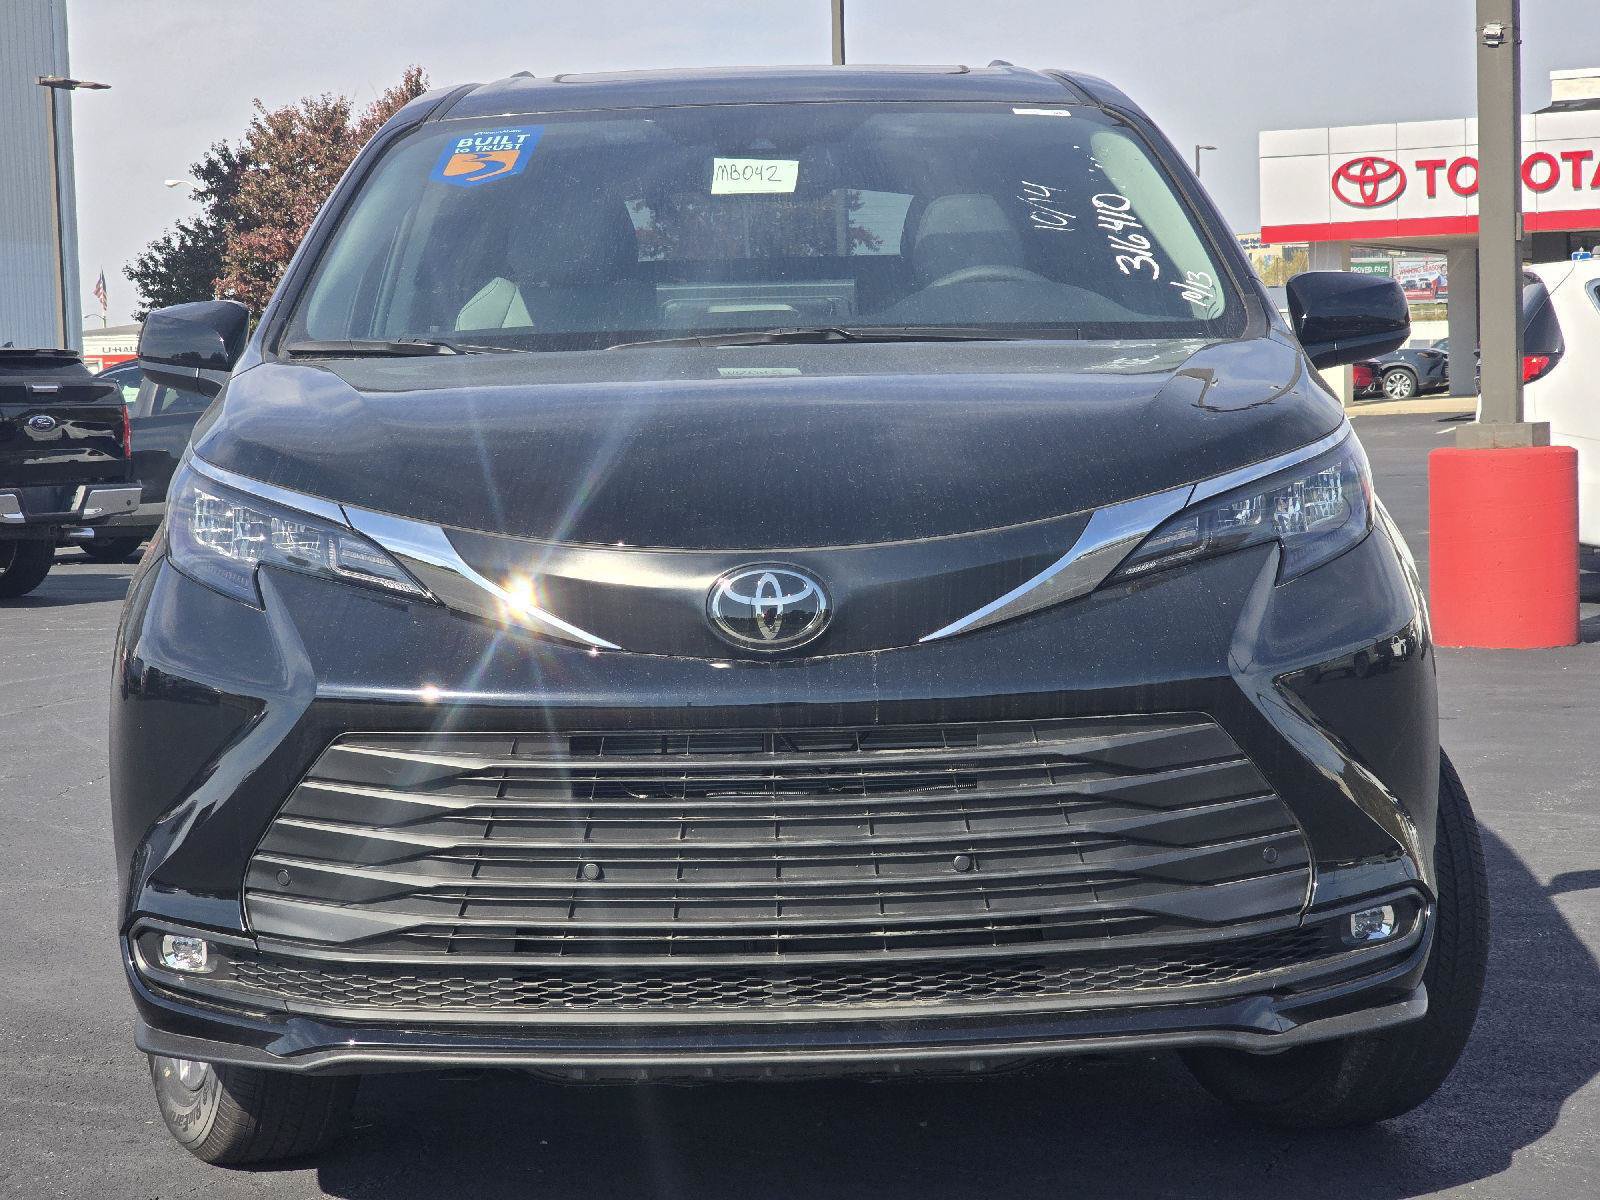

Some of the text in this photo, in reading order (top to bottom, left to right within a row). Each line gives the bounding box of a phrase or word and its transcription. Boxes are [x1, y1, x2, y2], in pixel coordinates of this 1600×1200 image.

[456, 133, 531, 149] BUILT
[475, 143, 524, 152] TRUST
[716, 164, 782, 181] MB042
[1415, 150, 1600, 199] TOOT
